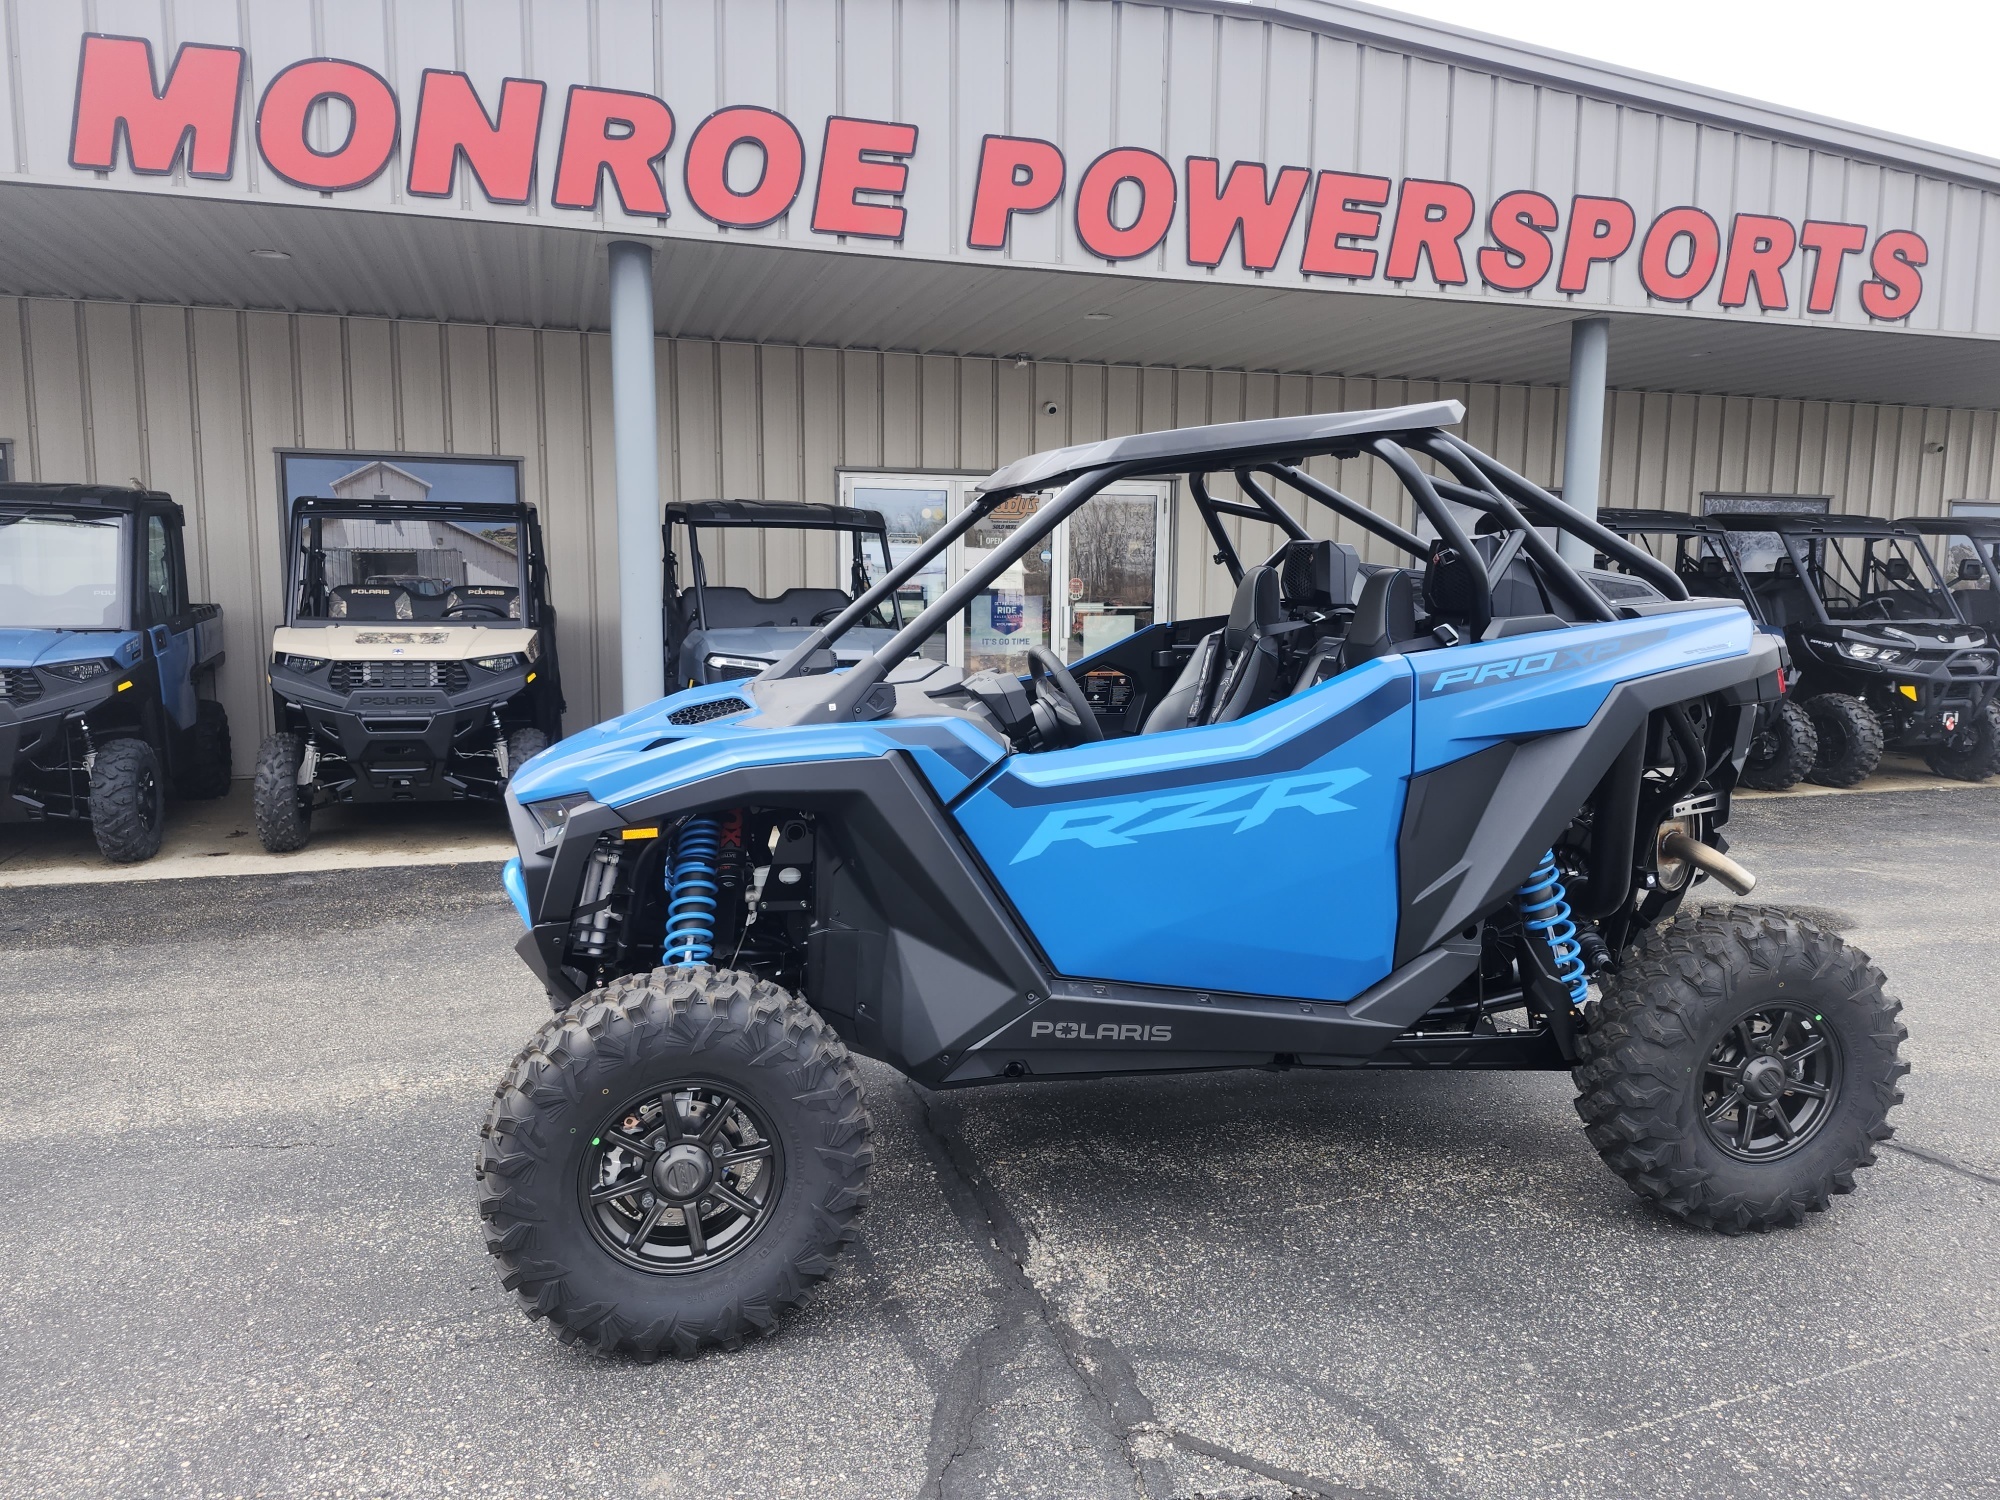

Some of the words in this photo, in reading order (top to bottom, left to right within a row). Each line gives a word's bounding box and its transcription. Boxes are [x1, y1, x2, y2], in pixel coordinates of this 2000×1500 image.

[68, 32, 919, 241] MONROE
[967, 133, 1928, 322] POWERSPORTS
[997, 606, 1017, 615] RIDE
[982, 638, 997, 646] IT'S
[998, 638, 1010, 646] GO
[1011, 638, 1030, 646] TIME
[1432, 652, 1558, 692] PRO
[1557, 640, 1623, 669] XP
[360, 696, 436, 706] POLARIS
[1009, 767, 1372, 866] RZR
[1031, 1021, 1172, 1042] POLARIS
